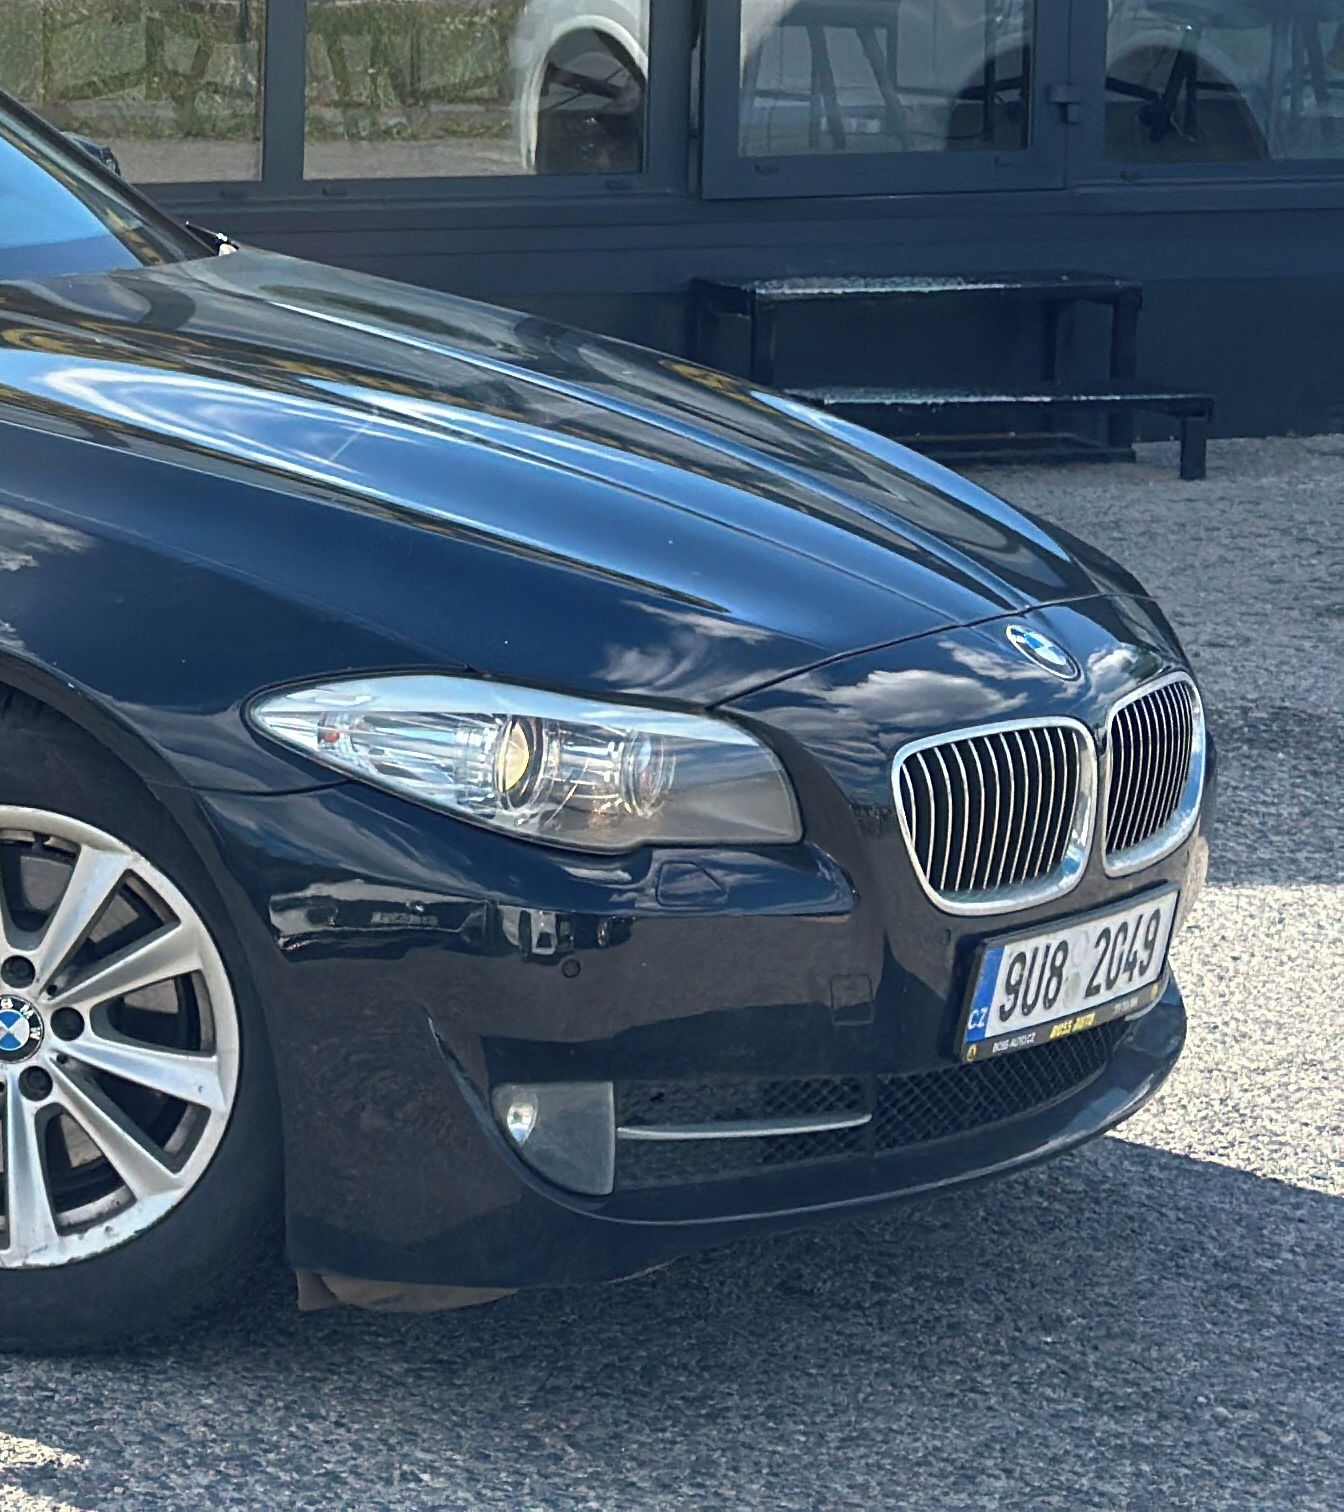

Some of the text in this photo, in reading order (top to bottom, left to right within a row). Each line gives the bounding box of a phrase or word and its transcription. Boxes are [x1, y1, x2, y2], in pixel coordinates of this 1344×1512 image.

[967, 907, 1161, 1031] CZ 9U8 2049
[0, 997, 42, 1041] BMW
